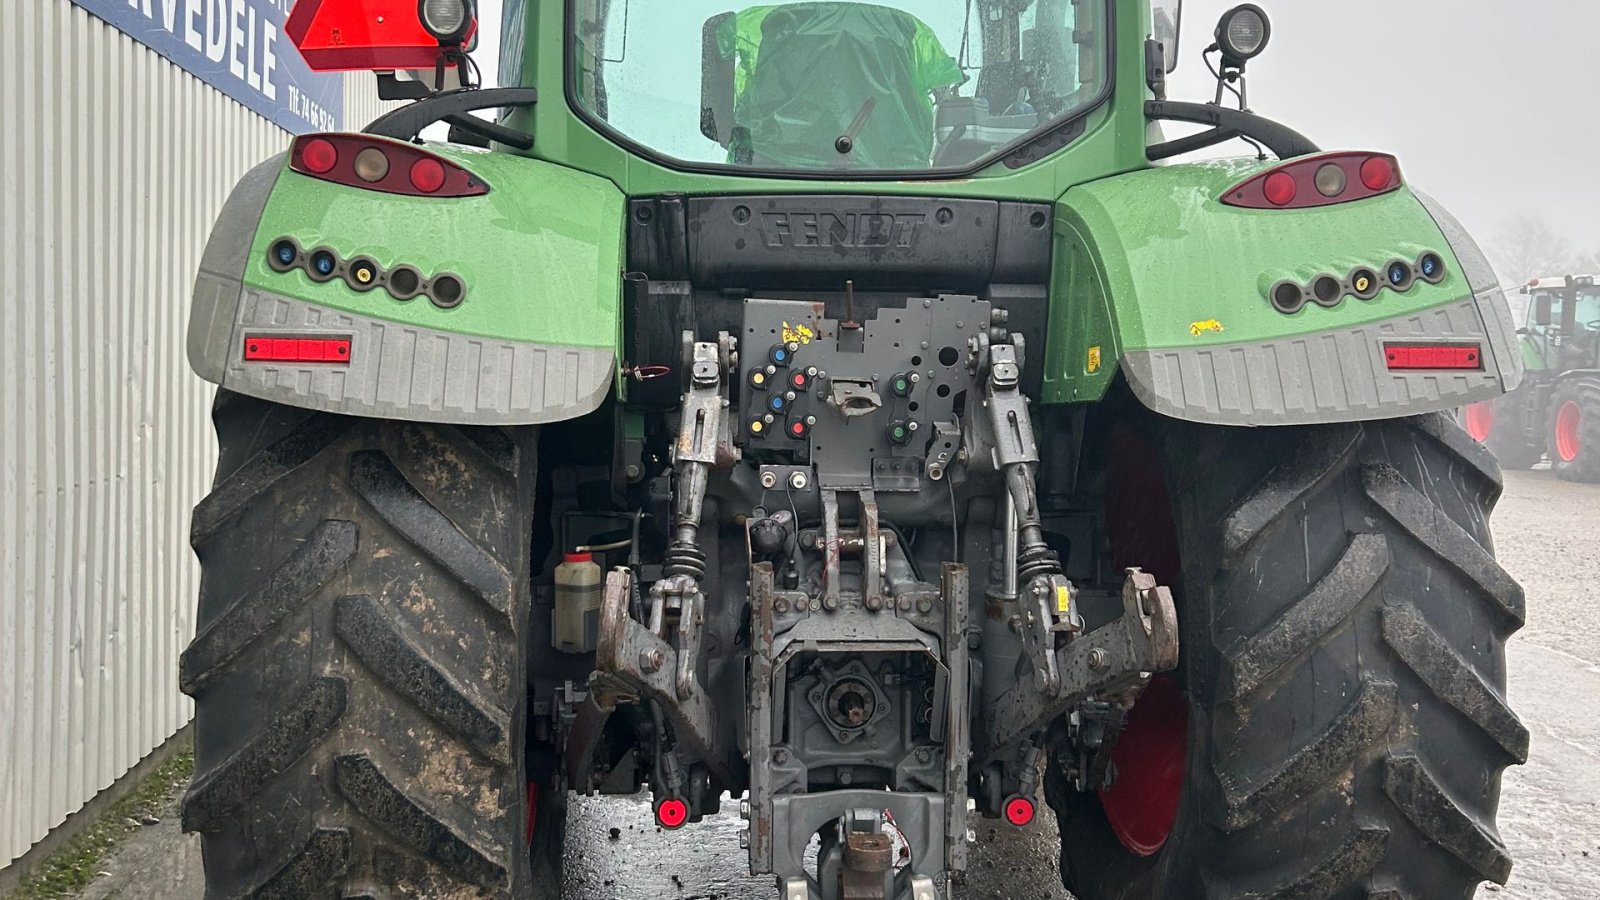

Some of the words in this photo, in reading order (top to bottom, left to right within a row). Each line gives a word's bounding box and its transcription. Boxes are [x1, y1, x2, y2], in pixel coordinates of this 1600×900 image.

[128, 0, 276, 101] EDELE
[301, 94, 310, 122] 74
[310, 101, 319, 128] 66
[320, 107, 328, 132] 92
[760, 211, 927, 249] FENDT
